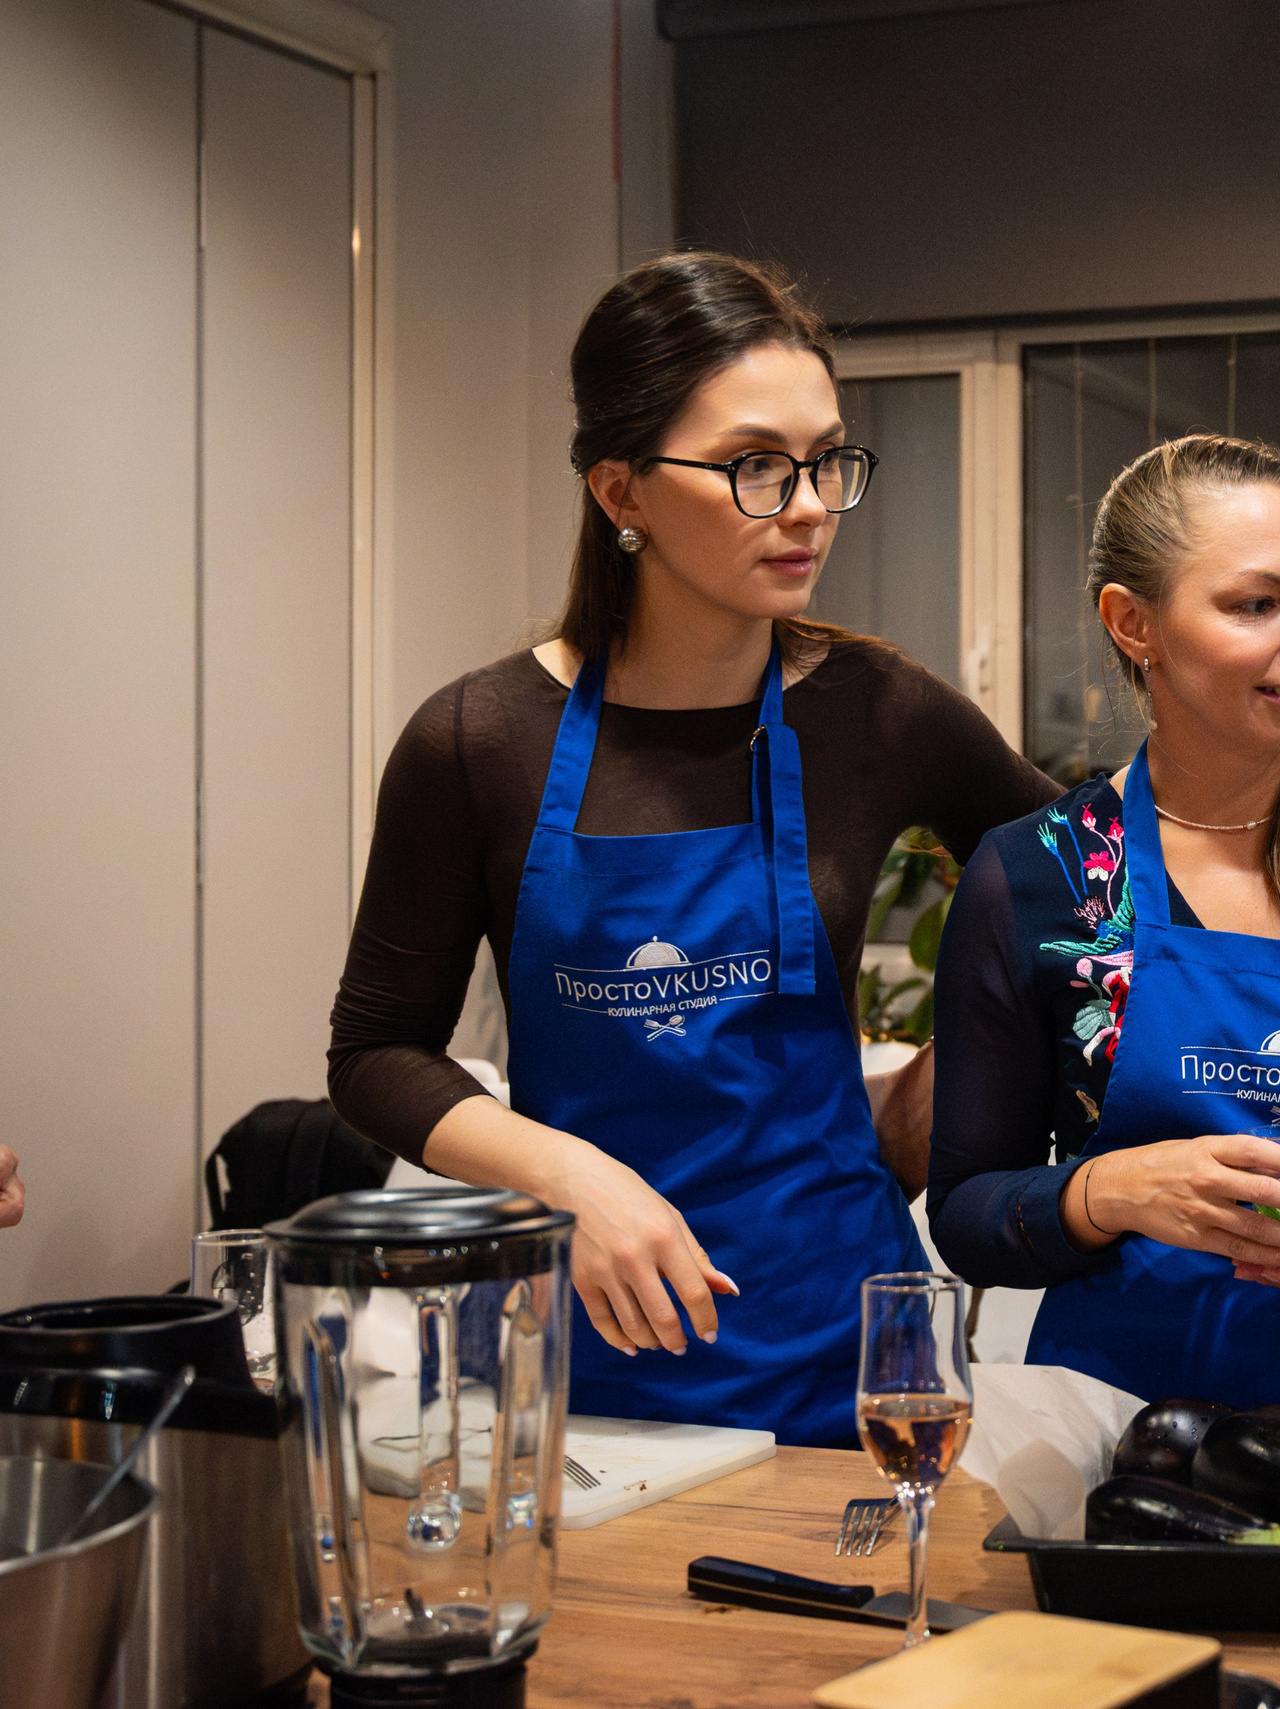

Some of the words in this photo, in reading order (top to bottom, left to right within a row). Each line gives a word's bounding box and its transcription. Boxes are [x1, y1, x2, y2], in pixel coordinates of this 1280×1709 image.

[555, 958, 771, 1002] ПростоVKUSNO
[608, 1003, 676, 1017] КУЛИНАРНАЯ
[678, 995, 718, 1010] СТУДИЯ
